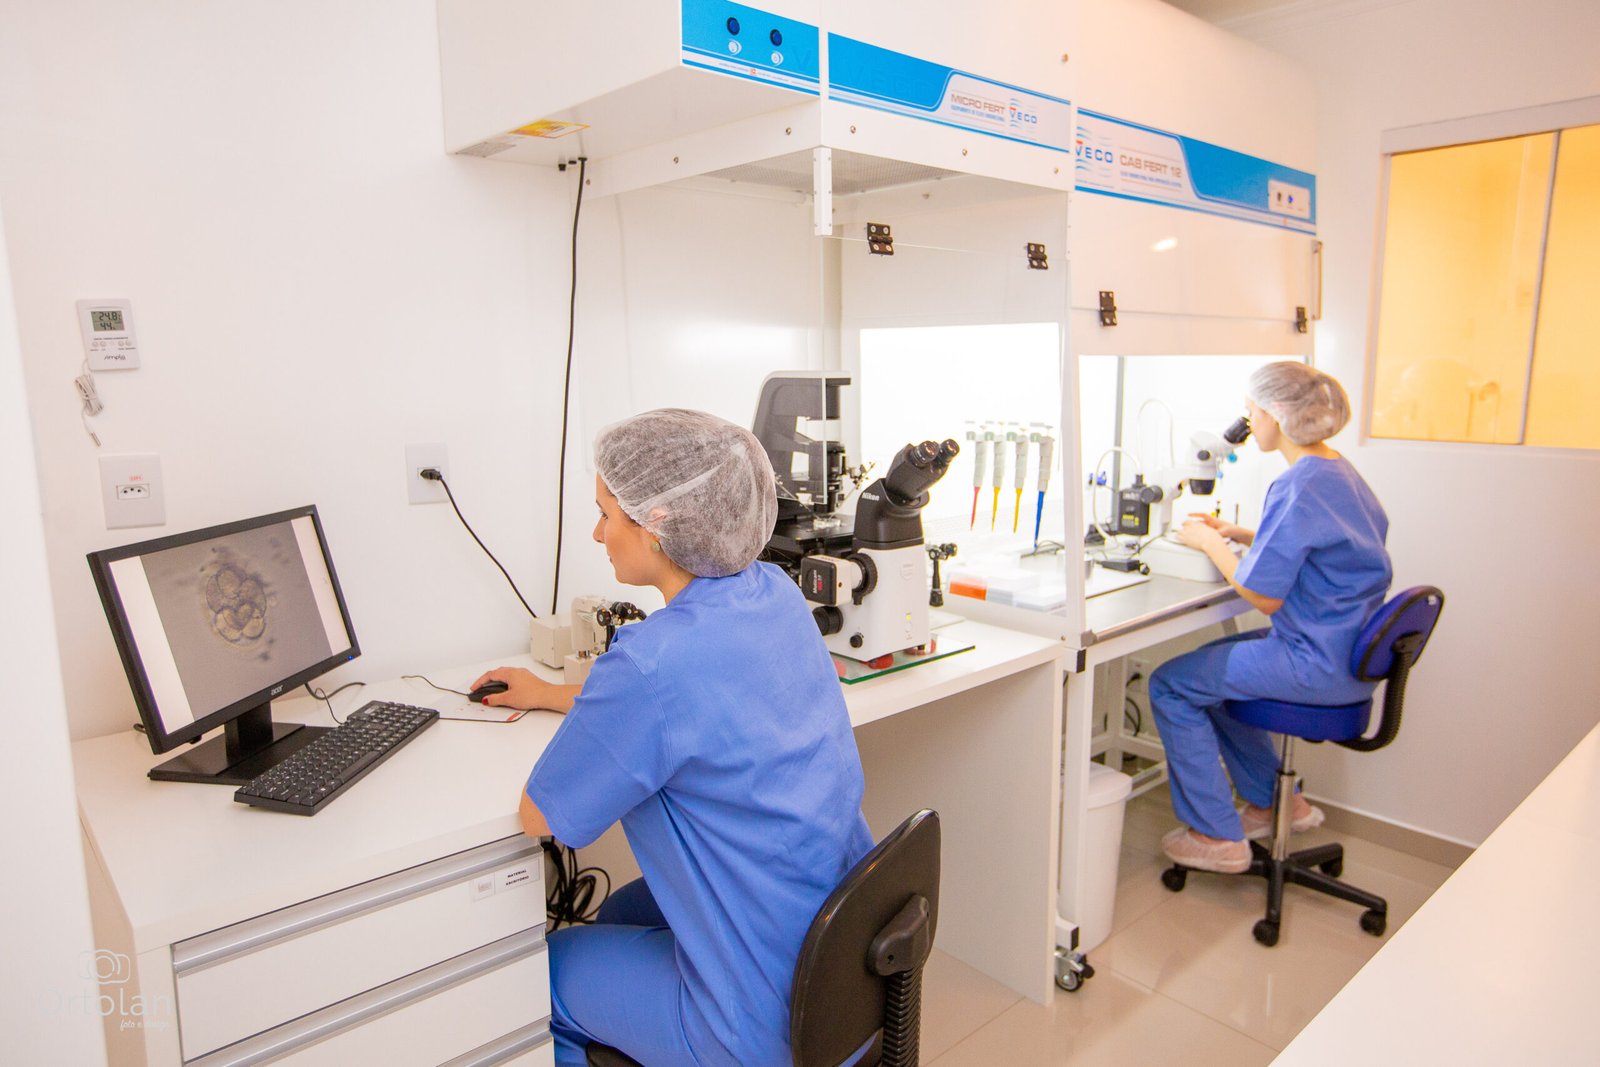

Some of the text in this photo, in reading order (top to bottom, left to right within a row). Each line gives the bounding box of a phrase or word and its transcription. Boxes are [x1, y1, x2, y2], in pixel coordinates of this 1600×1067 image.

[951, 93, 982, 109] MICRO
[983, 102, 1005, 114] FERT
[1009, 106, 1037, 124] VECO
[1076, 140, 1113, 163] VECO
[1120, 154, 1182, 178] CAB FERT 12
[861, 491, 880, 502] Nikon
[271, 684, 284, 696] acer
